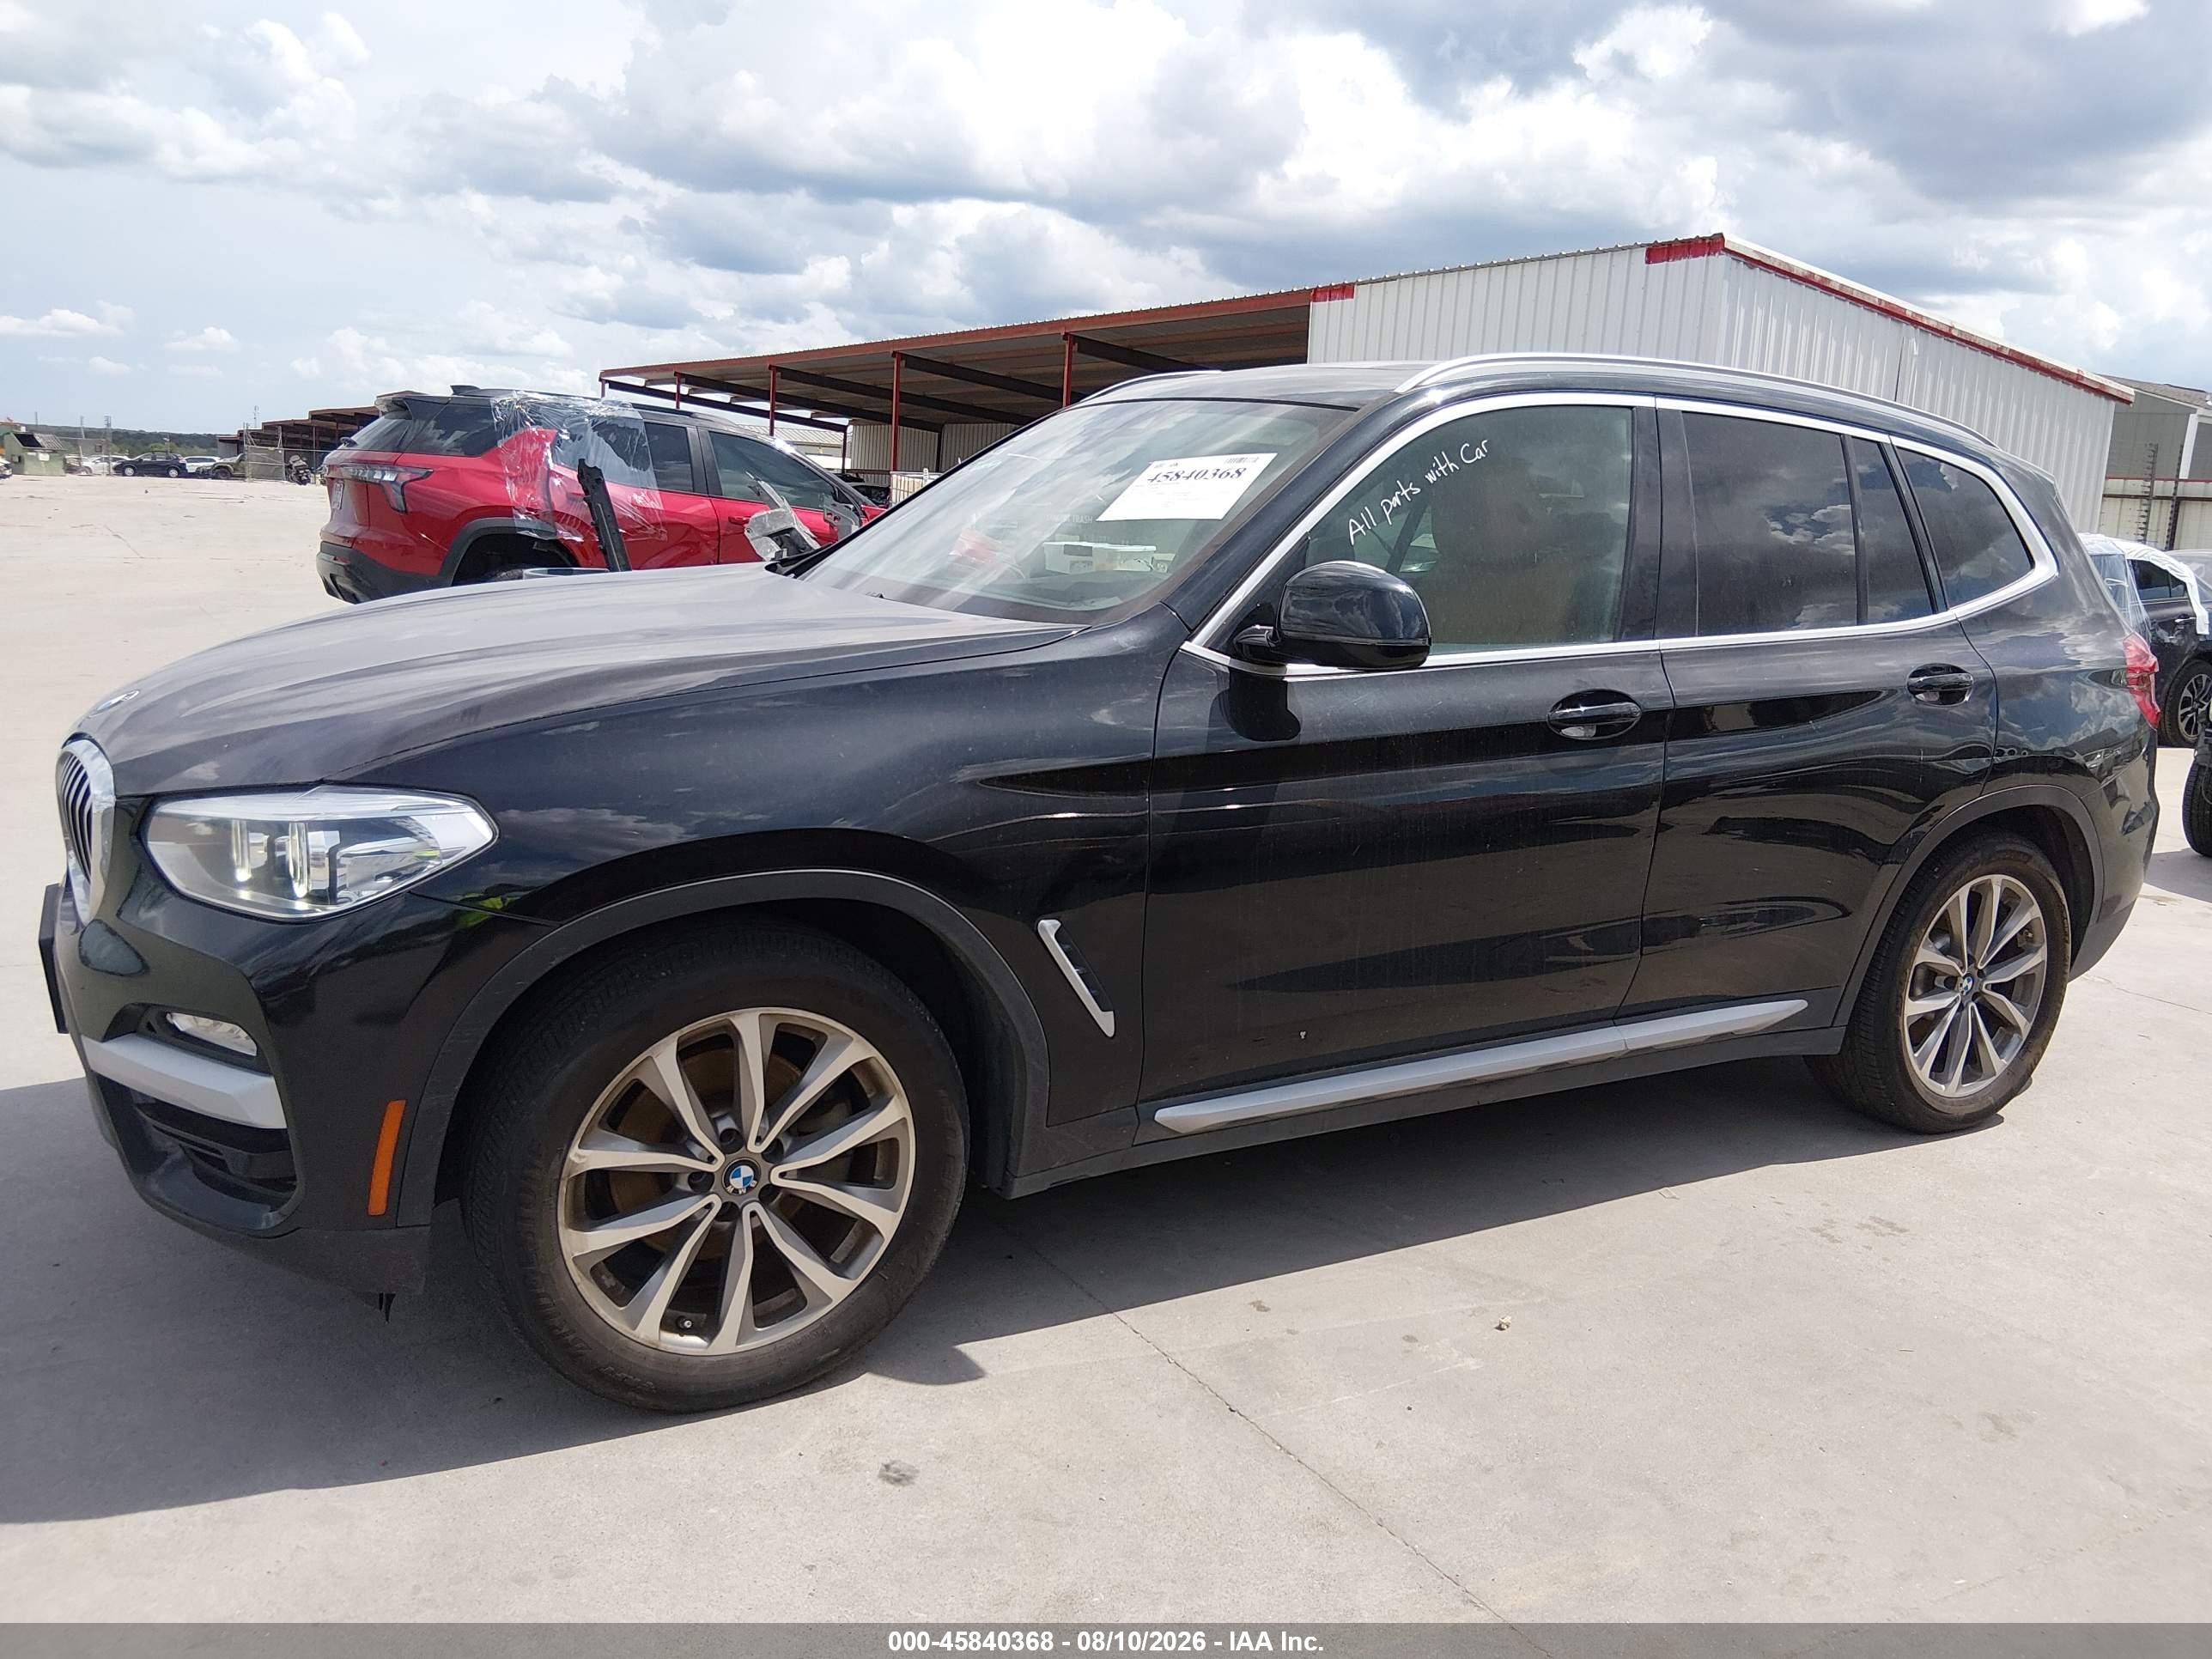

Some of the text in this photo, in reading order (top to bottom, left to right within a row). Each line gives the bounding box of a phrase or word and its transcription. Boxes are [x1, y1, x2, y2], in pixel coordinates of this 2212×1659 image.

[1147, 467, 1247, 483] 45840368
[1348, 439, 1488, 546] All parts with Car
